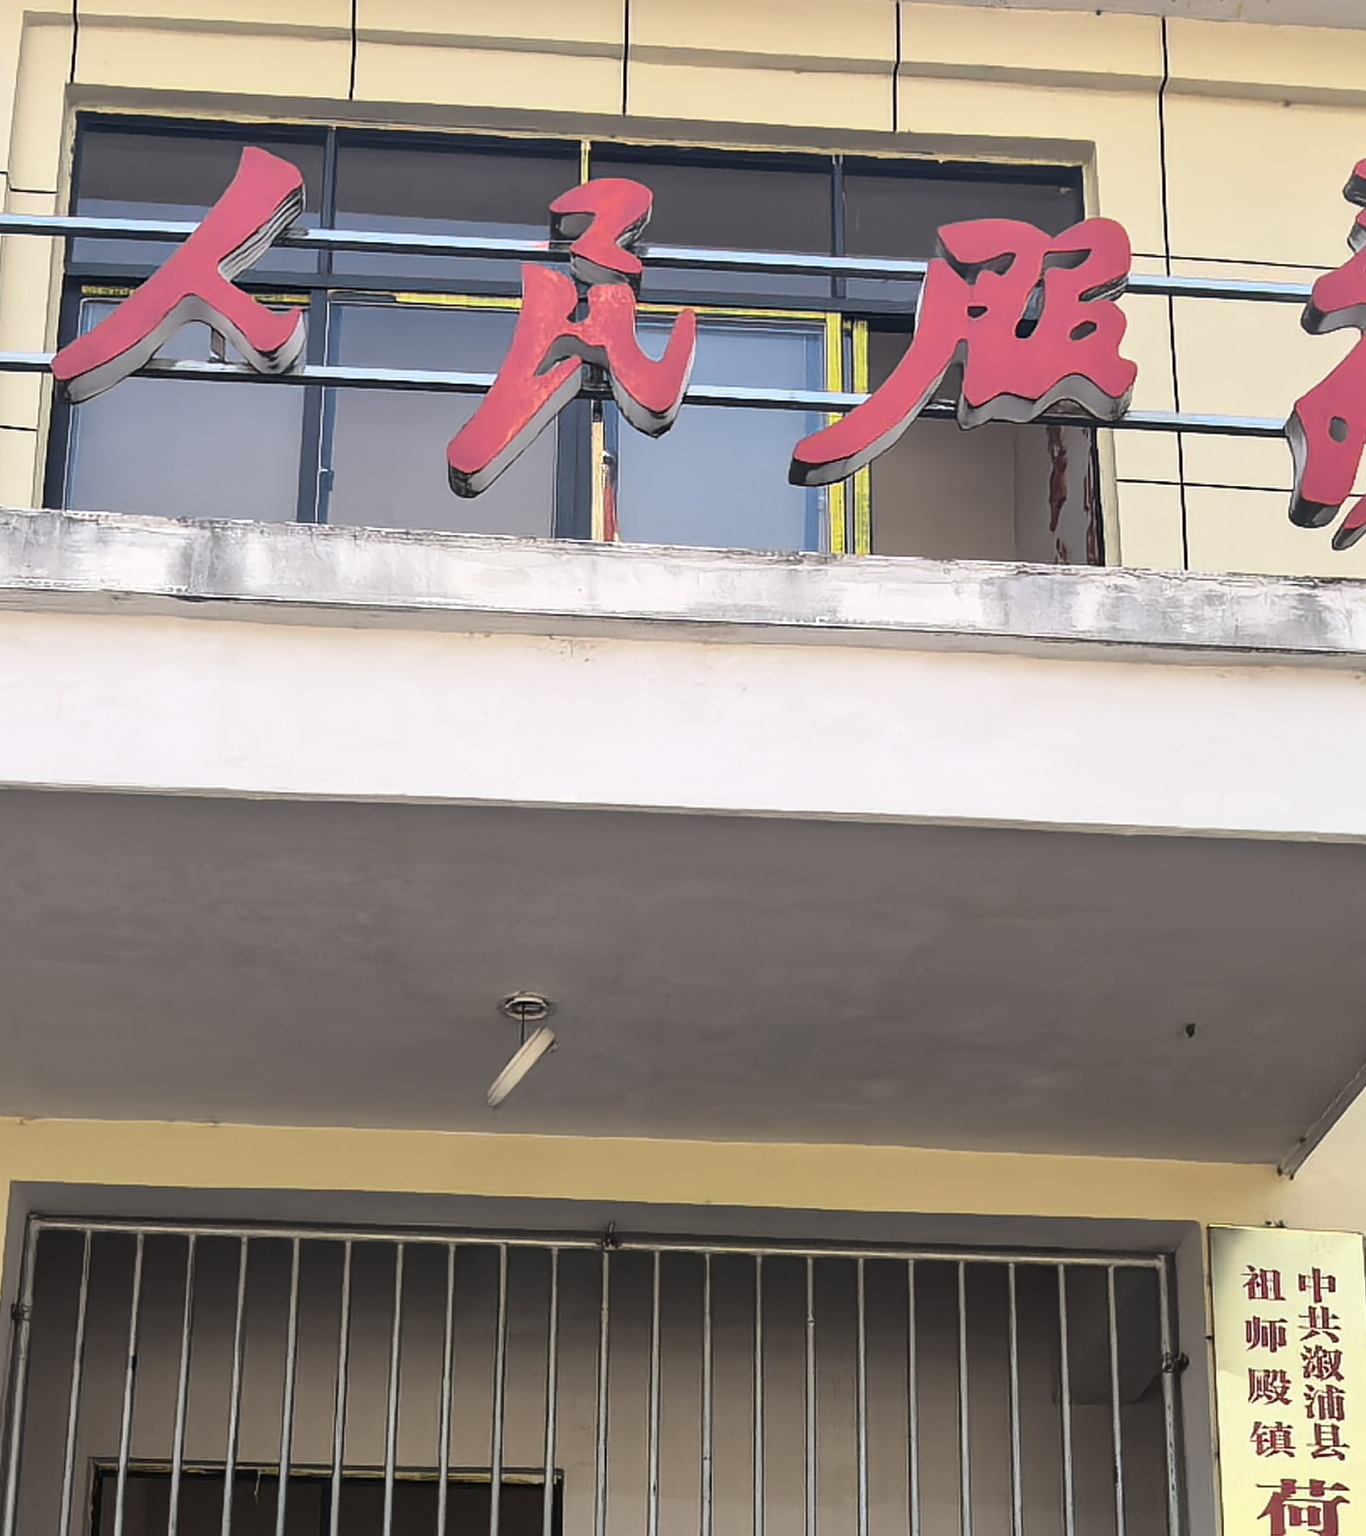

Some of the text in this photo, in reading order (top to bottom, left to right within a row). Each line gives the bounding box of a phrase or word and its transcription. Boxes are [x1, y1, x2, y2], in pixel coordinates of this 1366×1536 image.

[1242, 1266, 1297, 1458] 祖师殿镇
[1297, 1267, 1351, 1462] 中共溆浦县
